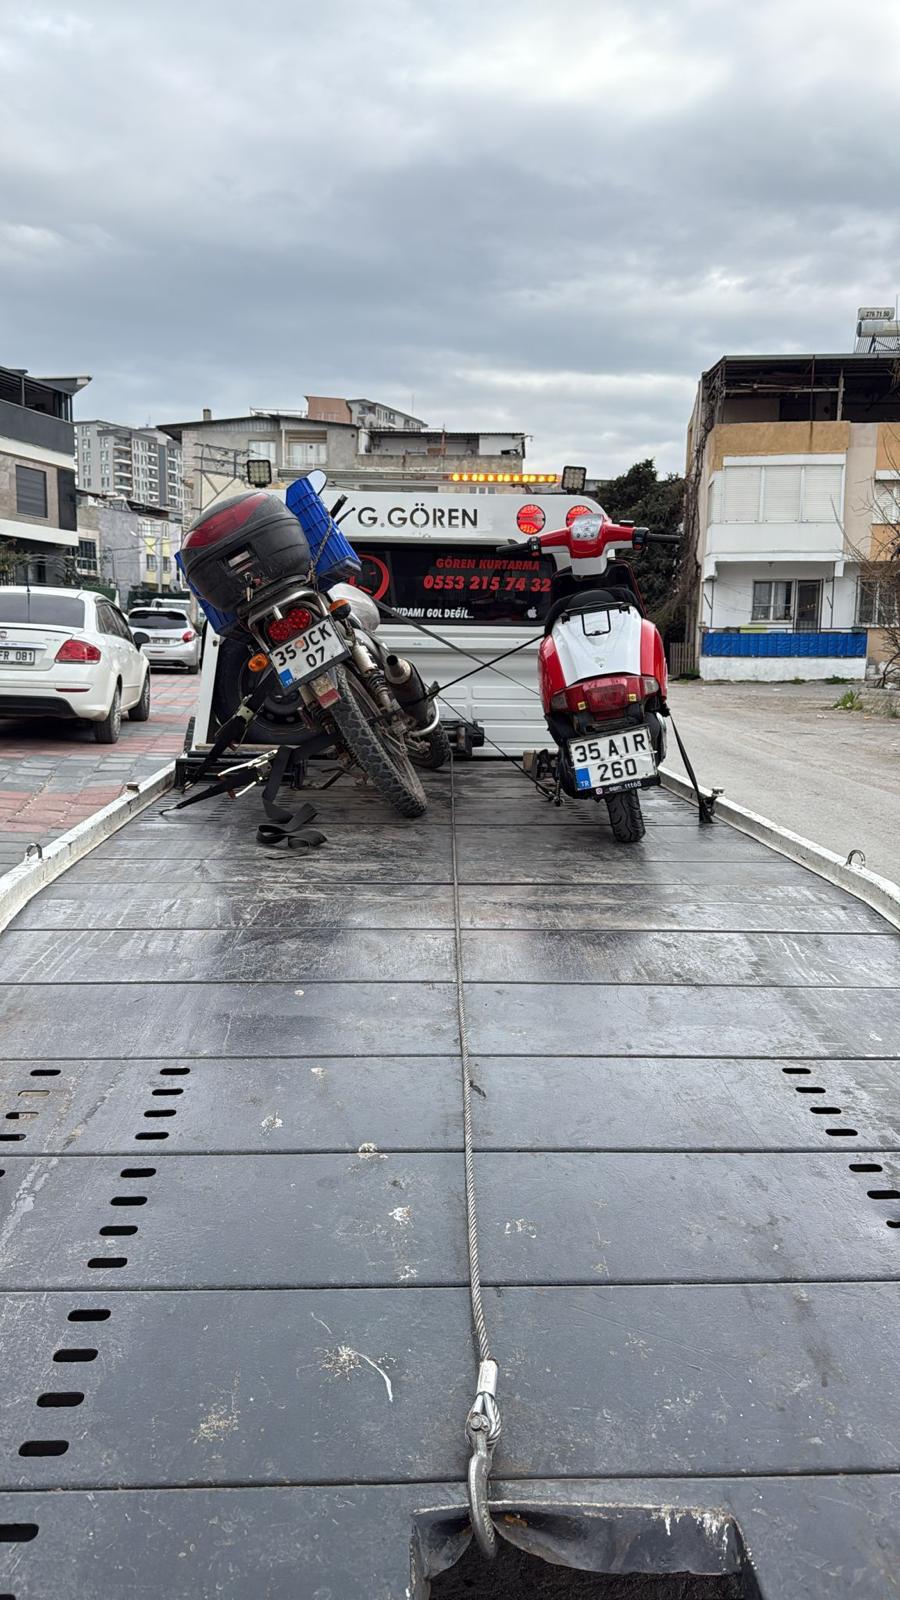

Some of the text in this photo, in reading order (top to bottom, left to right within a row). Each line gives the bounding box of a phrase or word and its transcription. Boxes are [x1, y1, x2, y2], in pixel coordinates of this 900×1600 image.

[357, 502, 478, 528] G.GÖREN
[436, 555, 541, 570] GÖREN KURTARMA
[423, 575, 552, 592] 0553 215 74 32
[426, 608, 442, 618] GOL
[274, 623, 332, 667] 35 JCK
[305, 646, 325, 668] 07
[574, 733, 646, 763] 35 AIR
[597, 758, 637, 782] 260
